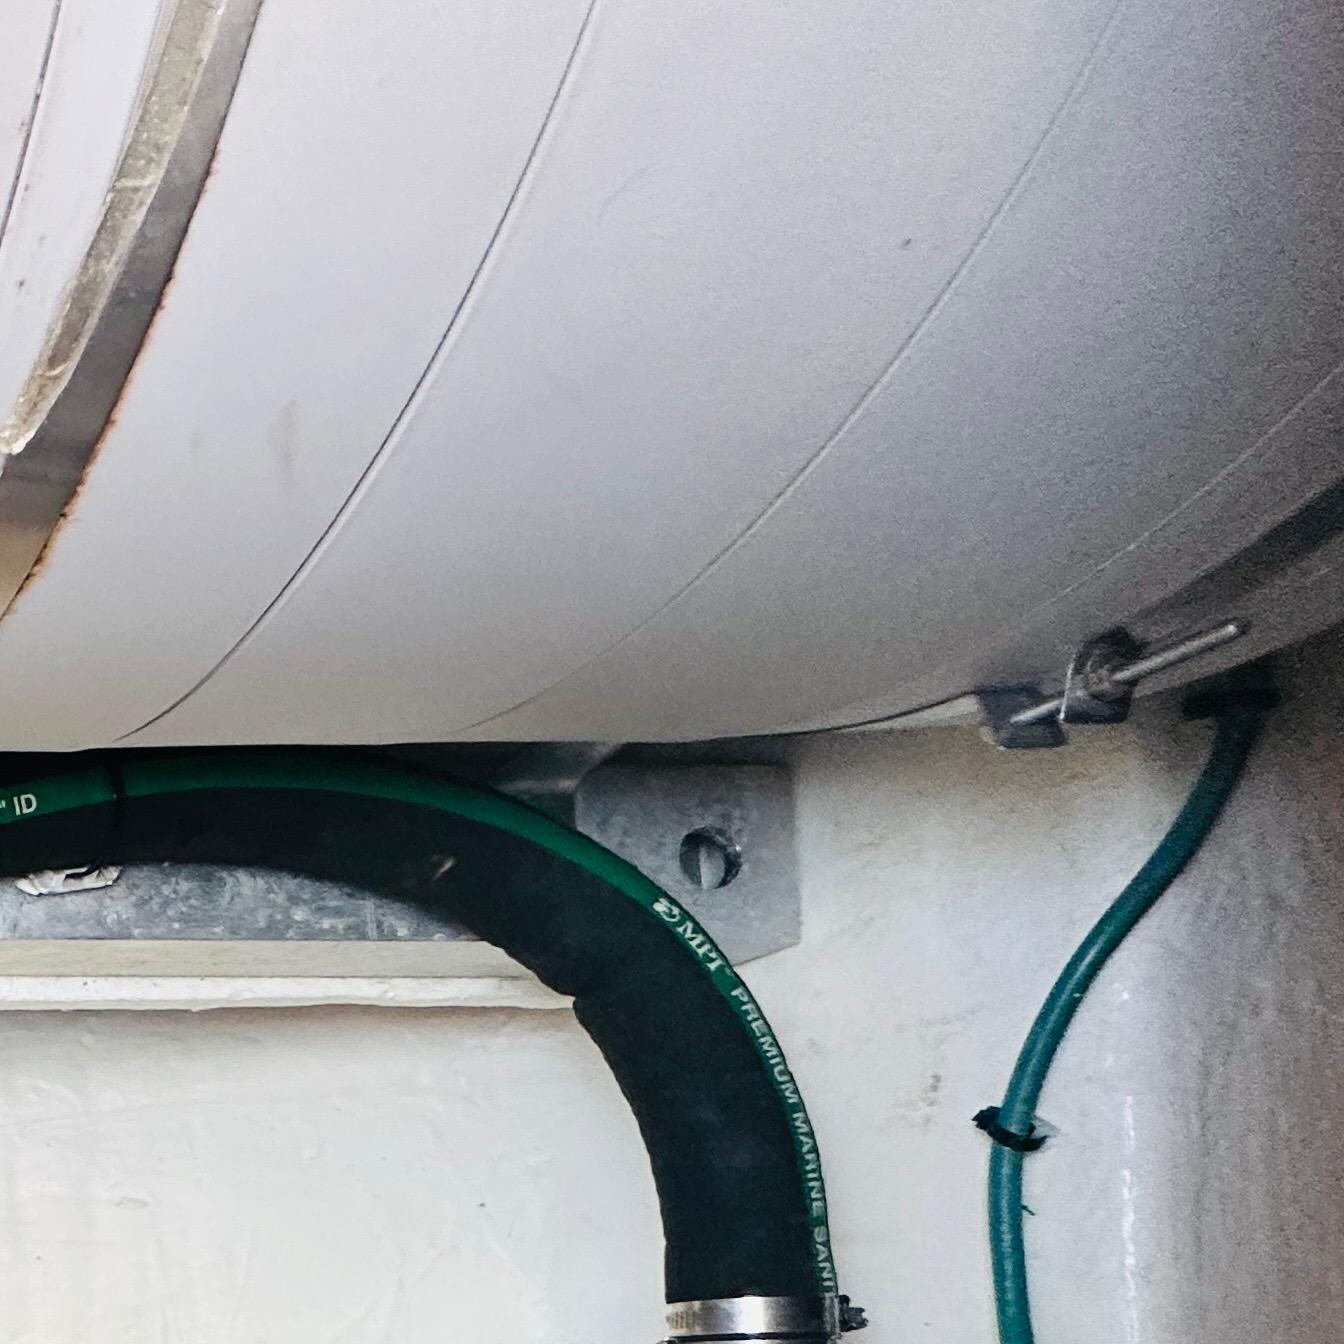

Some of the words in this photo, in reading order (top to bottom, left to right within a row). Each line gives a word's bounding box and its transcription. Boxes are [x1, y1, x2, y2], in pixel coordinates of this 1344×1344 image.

[11, 791, 39, 816] ID
[730, 985, 800, 1104] PREMIUM
[791, 1111, 826, 1216] MARINE
